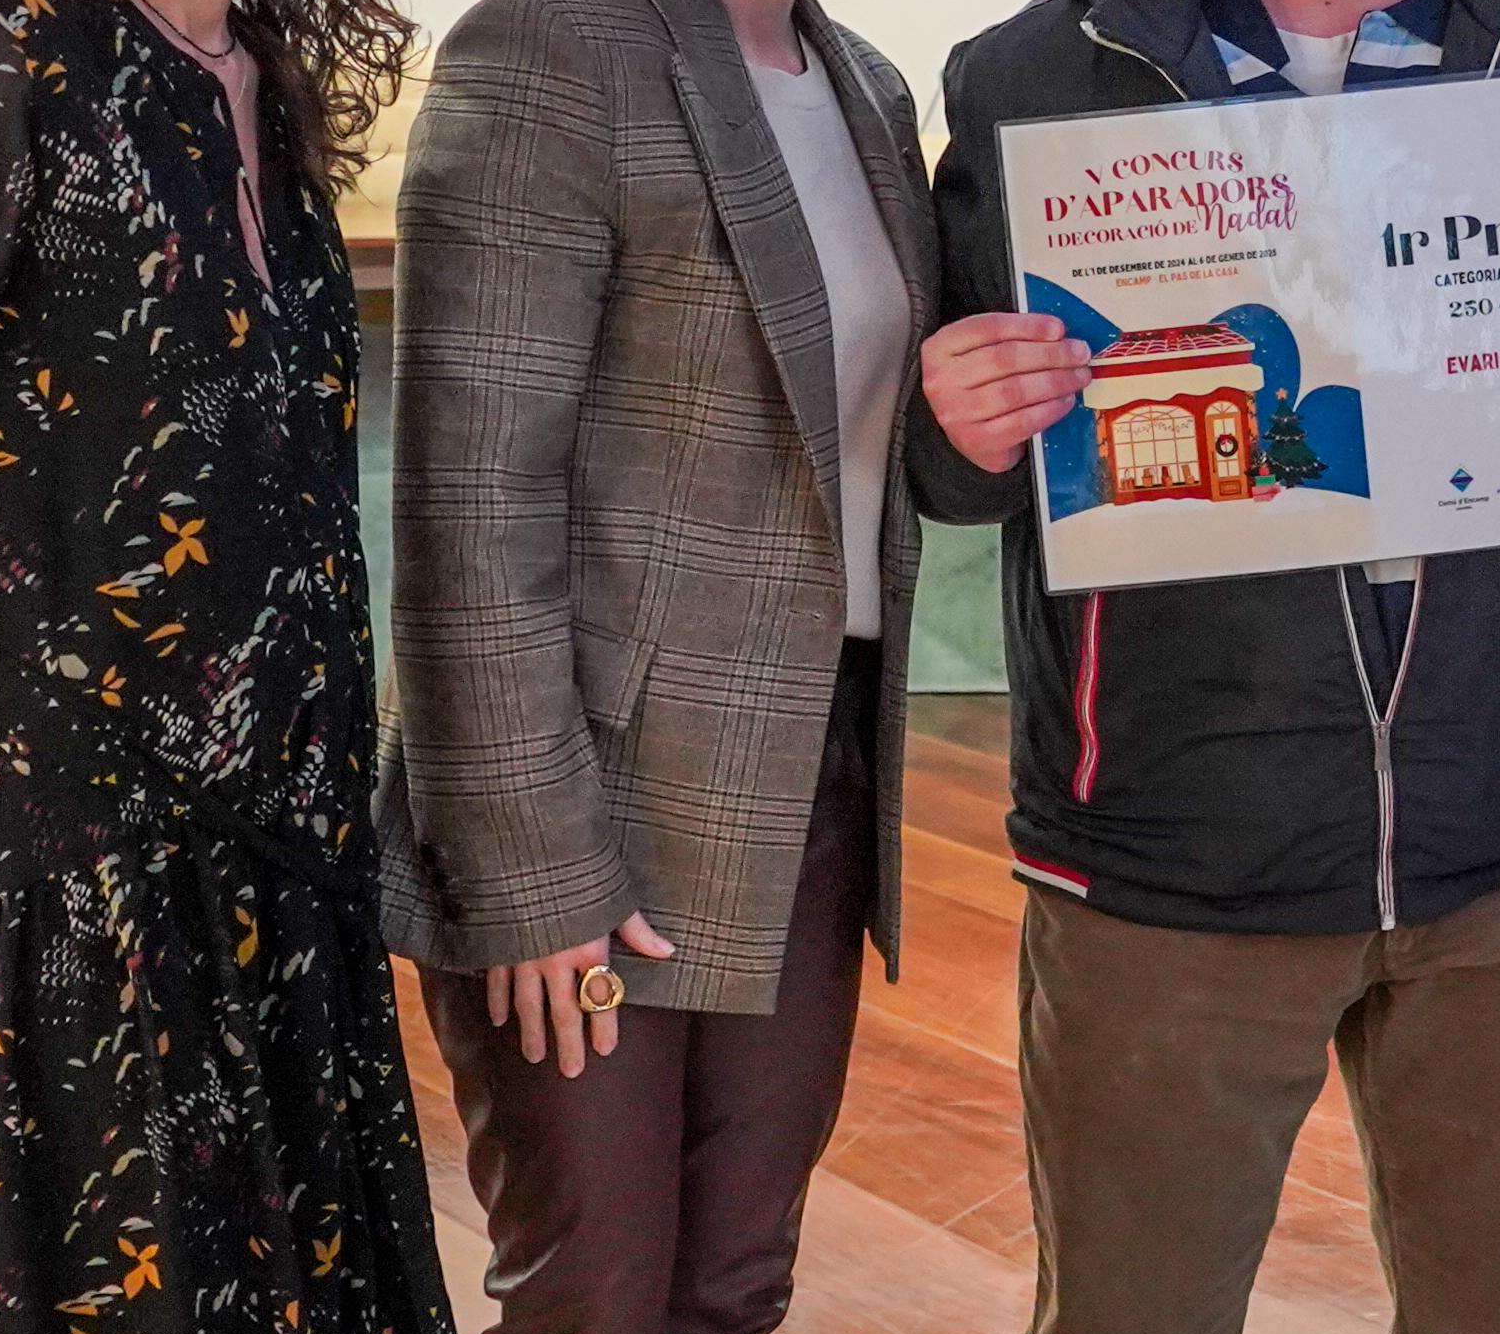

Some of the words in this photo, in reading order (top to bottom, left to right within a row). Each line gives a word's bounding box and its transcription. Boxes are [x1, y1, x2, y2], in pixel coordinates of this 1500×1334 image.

[1084, 164, 1104, 185] V
[1111, 150, 1244, 181] CONCURS
[1043, 173, 1291, 223] D'APARADORS
[1057, 220, 1169, 248] DECORACIÓ
[1172, 219, 1199, 237] DE
[1196, 189, 1298, 240] Nadal
[1380, 222, 1430, 268] 1r
[1072, 268, 1083, 278] DE
[1096, 266, 1108, 276] DE
[1109, 261, 1153, 274] DESEMBRE
[1154, 260, 1165, 270] DE
[1167, 258, 1186, 268] 2024
[1188, 257, 1198, 266] AL
[1206, 254, 1217, 264] DE
[1218, 251, 1246, 263] GENER
[1246, 250, 1258, 260] DE
[1259, 248, 1278, 258] 2025
[1115, 275, 1152, 288] ENCAMP
[1158, 273, 1169, 284] EL
[1170, 271, 1188, 282] PAS
[1189, 269, 1202, 280] DE
[1203, 268, 1214, 279] LA
[1215, 266, 1240, 278] CASA
[1448, 297, 1494, 319] 250
